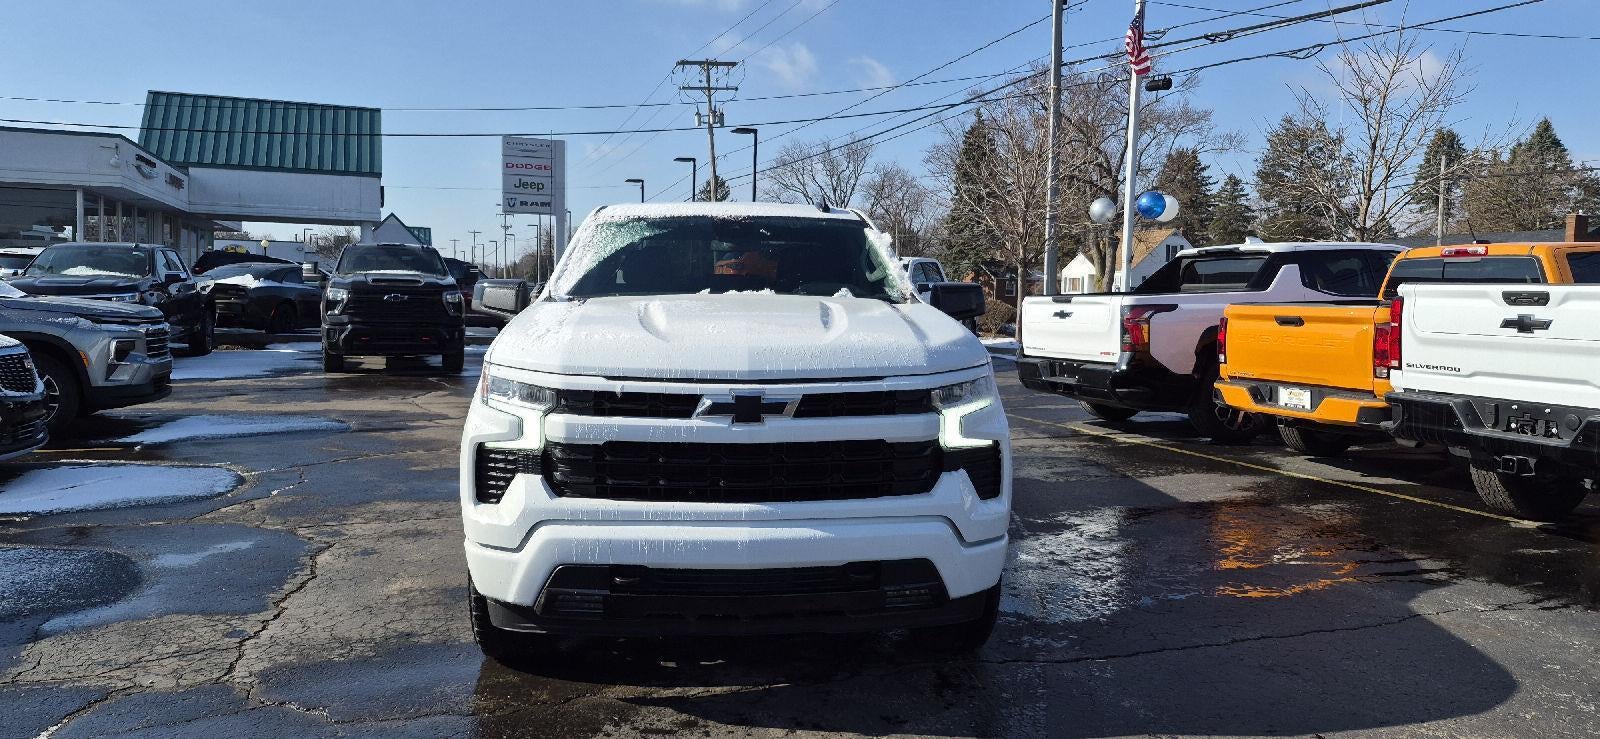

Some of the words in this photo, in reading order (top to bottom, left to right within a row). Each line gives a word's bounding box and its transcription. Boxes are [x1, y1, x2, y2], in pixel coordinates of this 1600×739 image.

[506, 162, 551, 170] DODGE
[514, 178, 544, 191] Jeep
[1405, 362, 1461, 373] SILVERADO
